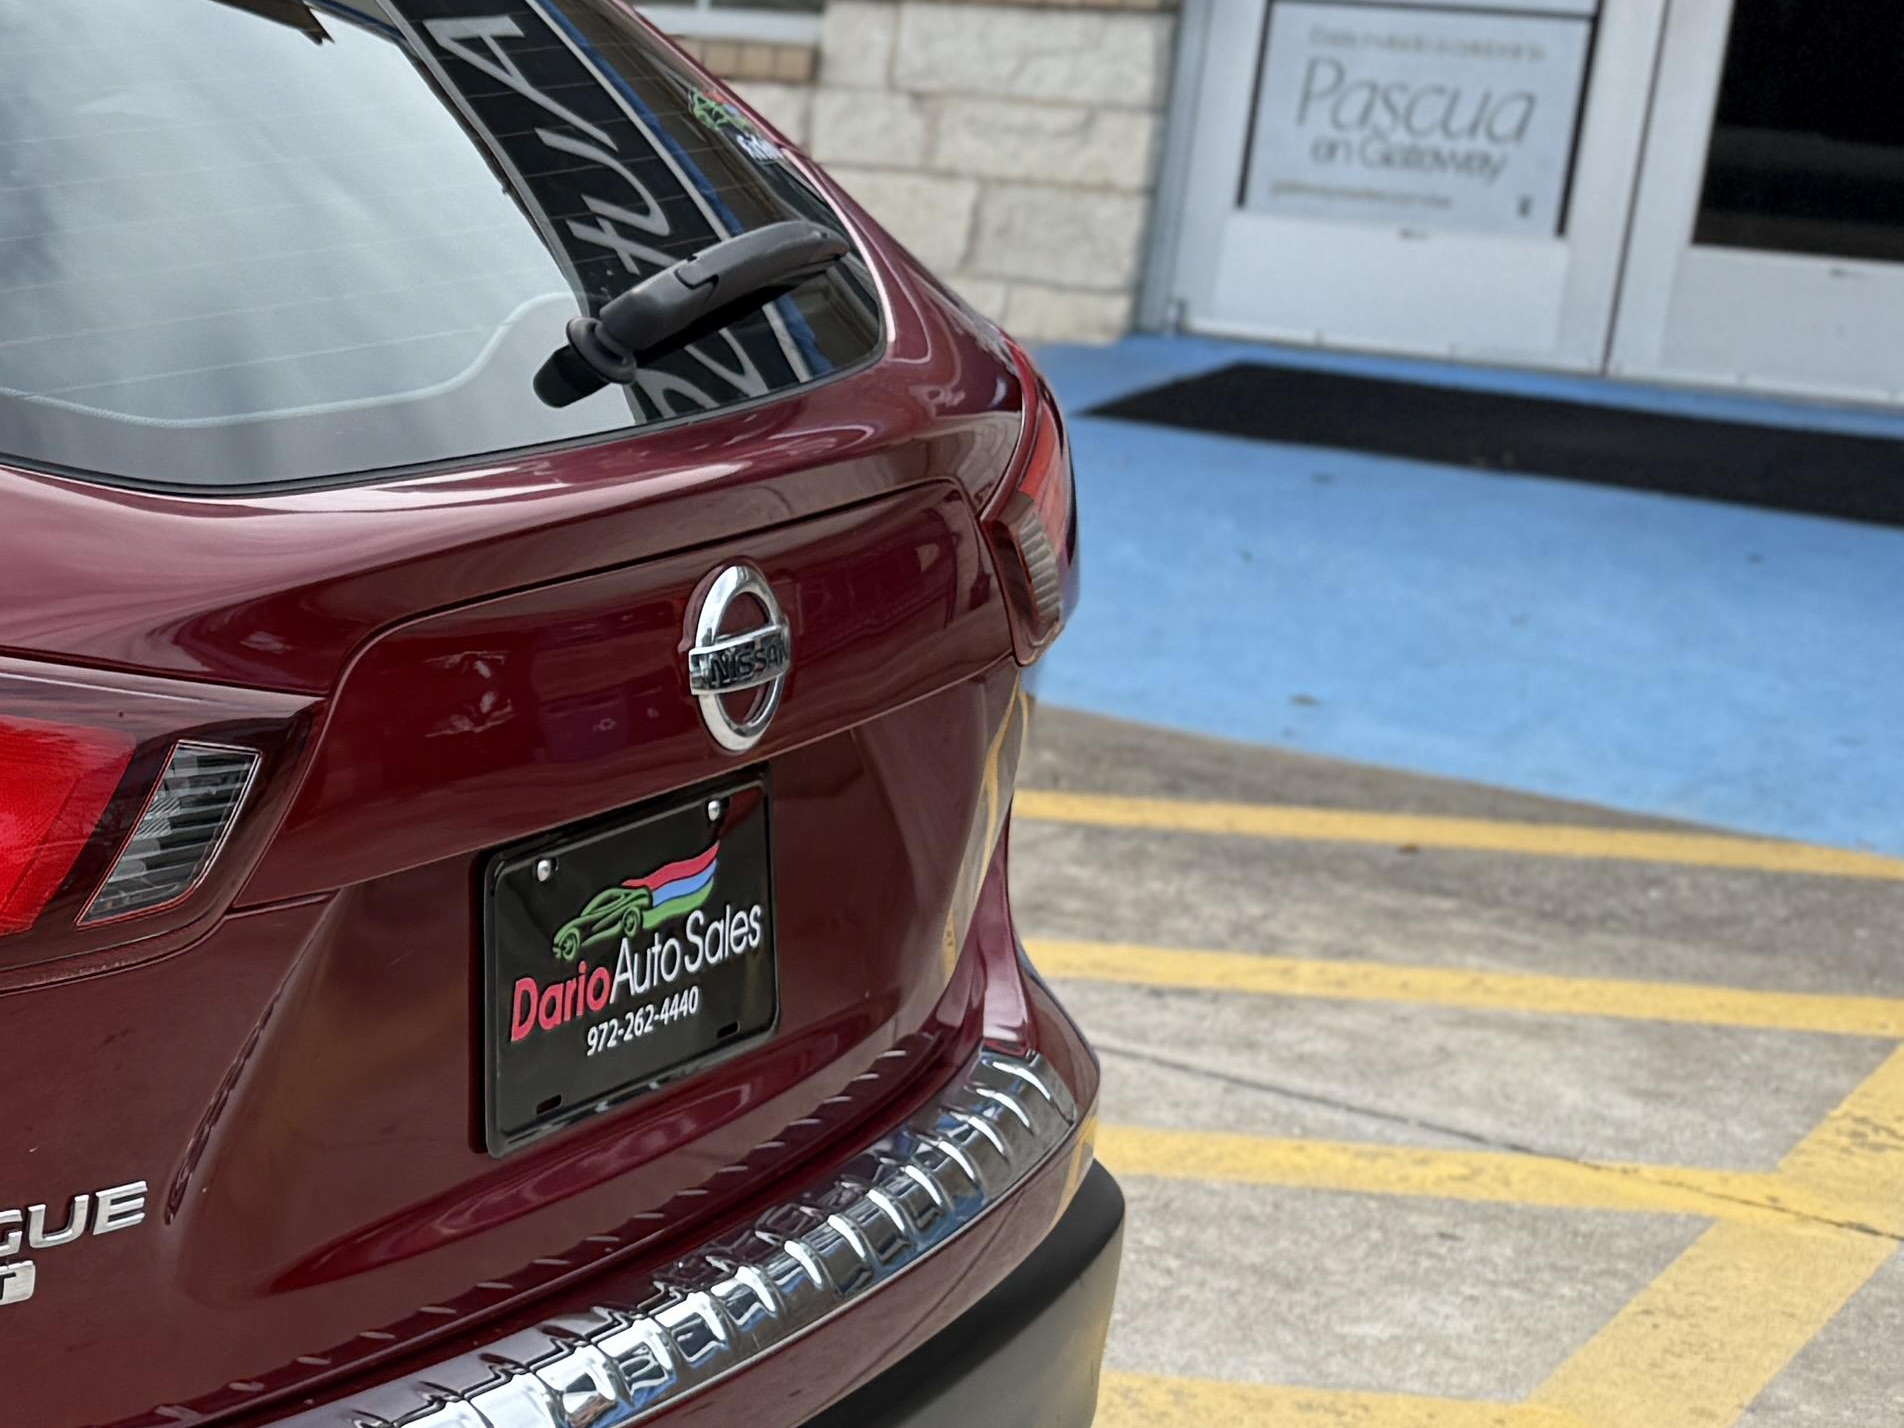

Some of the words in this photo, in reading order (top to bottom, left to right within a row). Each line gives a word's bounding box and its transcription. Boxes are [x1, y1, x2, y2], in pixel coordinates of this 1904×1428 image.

[1296, 56, 1538, 144] Pascua
[1360, 136, 1508, 186] Gateway
[710, 642, 789, 689] NISSAN
[587, 986, 700, 1057] 972-262-4440
